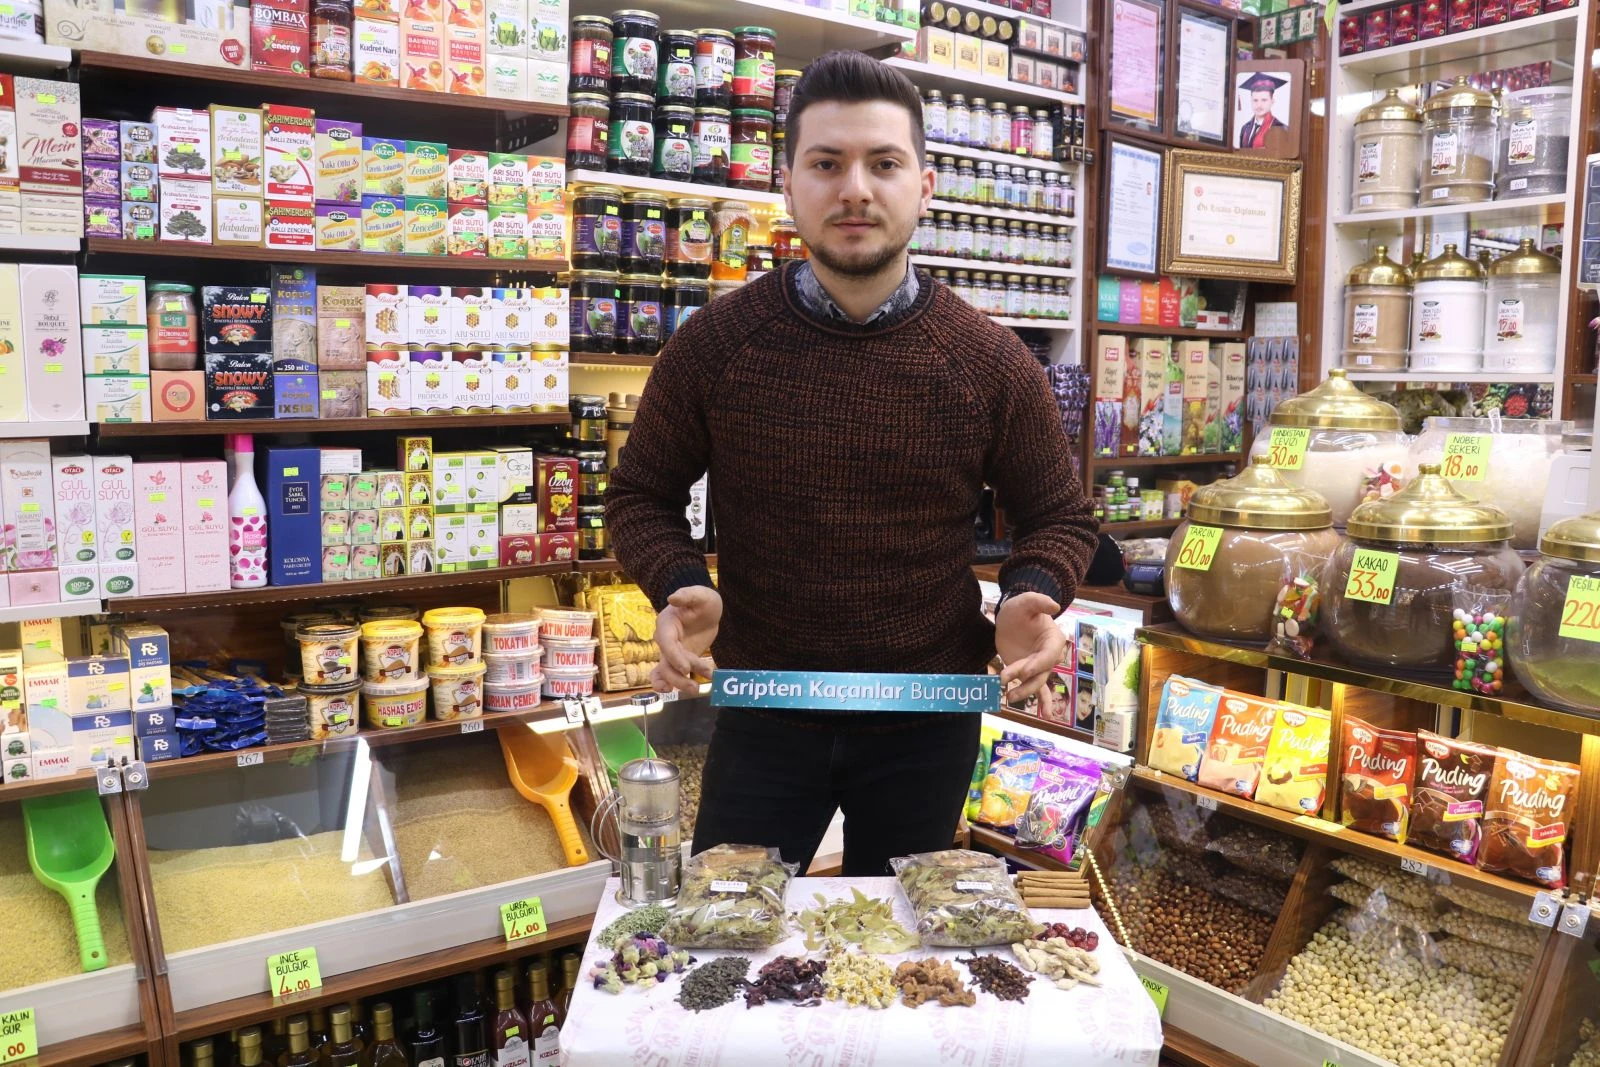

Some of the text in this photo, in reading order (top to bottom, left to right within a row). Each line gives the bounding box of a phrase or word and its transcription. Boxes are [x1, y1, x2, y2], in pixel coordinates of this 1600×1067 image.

[255, 8, 308, 28] BOMBAX
[271, 43, 301, 53] energy
[359, 43, 382, 52] Kudret
[330, 130, 351, 139] akzer
[22, 136, 76, 156] Mesir
[373, 147, 396, 156] akzer
[416, 151, 437, 160] akzer
[466, 164, 484, 172] SÜTÜ
[506, 169, 523, 177] SÜTÜ
[372, 206, 395, 214] akzer
[416, 208, 437, 217] akzer
[466, 218, 484, 226] SÜTÜ
[506, 221, 523, 229] SÜTÜ
[545, 222, 562, 230] SÜTÜ
[212, 304, 266, 318] SNOWY
[214, 371, 268, 386] SNOWY
[1271, 446, 1298, 467] 30,00
[1444, 455, 1478, 477] 18,00
[60, 478, 88, 491] GÜL
[101, 478, 127, 490] GÜL
[57, 490, 91, 501] SUYU
[98, 490, 130, 501] SUYU
[1190, 527, 1217, 539] TARÇIN
[1179, 539, 1211, 567] 60,00
[1357, 555, 1388, 572] KAKAO
[1347, 570, 1390, 600] 33,00
[494, 636, 528, 650] TOKAT'IN
[723, 676, 989, 705] Gripten Kaçanlar Buraya!
[377, 702, 405, 716] HAŞHAŞ
[1166, 697, 1211, 727] Puding
[462, 724, 480, 733] 260
[1221, 714, 1273, 743] Puding
[238, 753, 261, 765] 267
[1348, 744, 1408, 780] Puding
[1421, 757, 1486, 795] Puding
[1500, 779, 1565, 818] Puding
[1402, 860, 1423, 874] 282
[508, 900, 529, 912] URFA
[506, 906, 538, 922] BULGURU
[276, 961, 310, 976] BULGUR
[2, 1011, 30, 1025] KALIN
[0, 1023, 22, 1037] GUR
